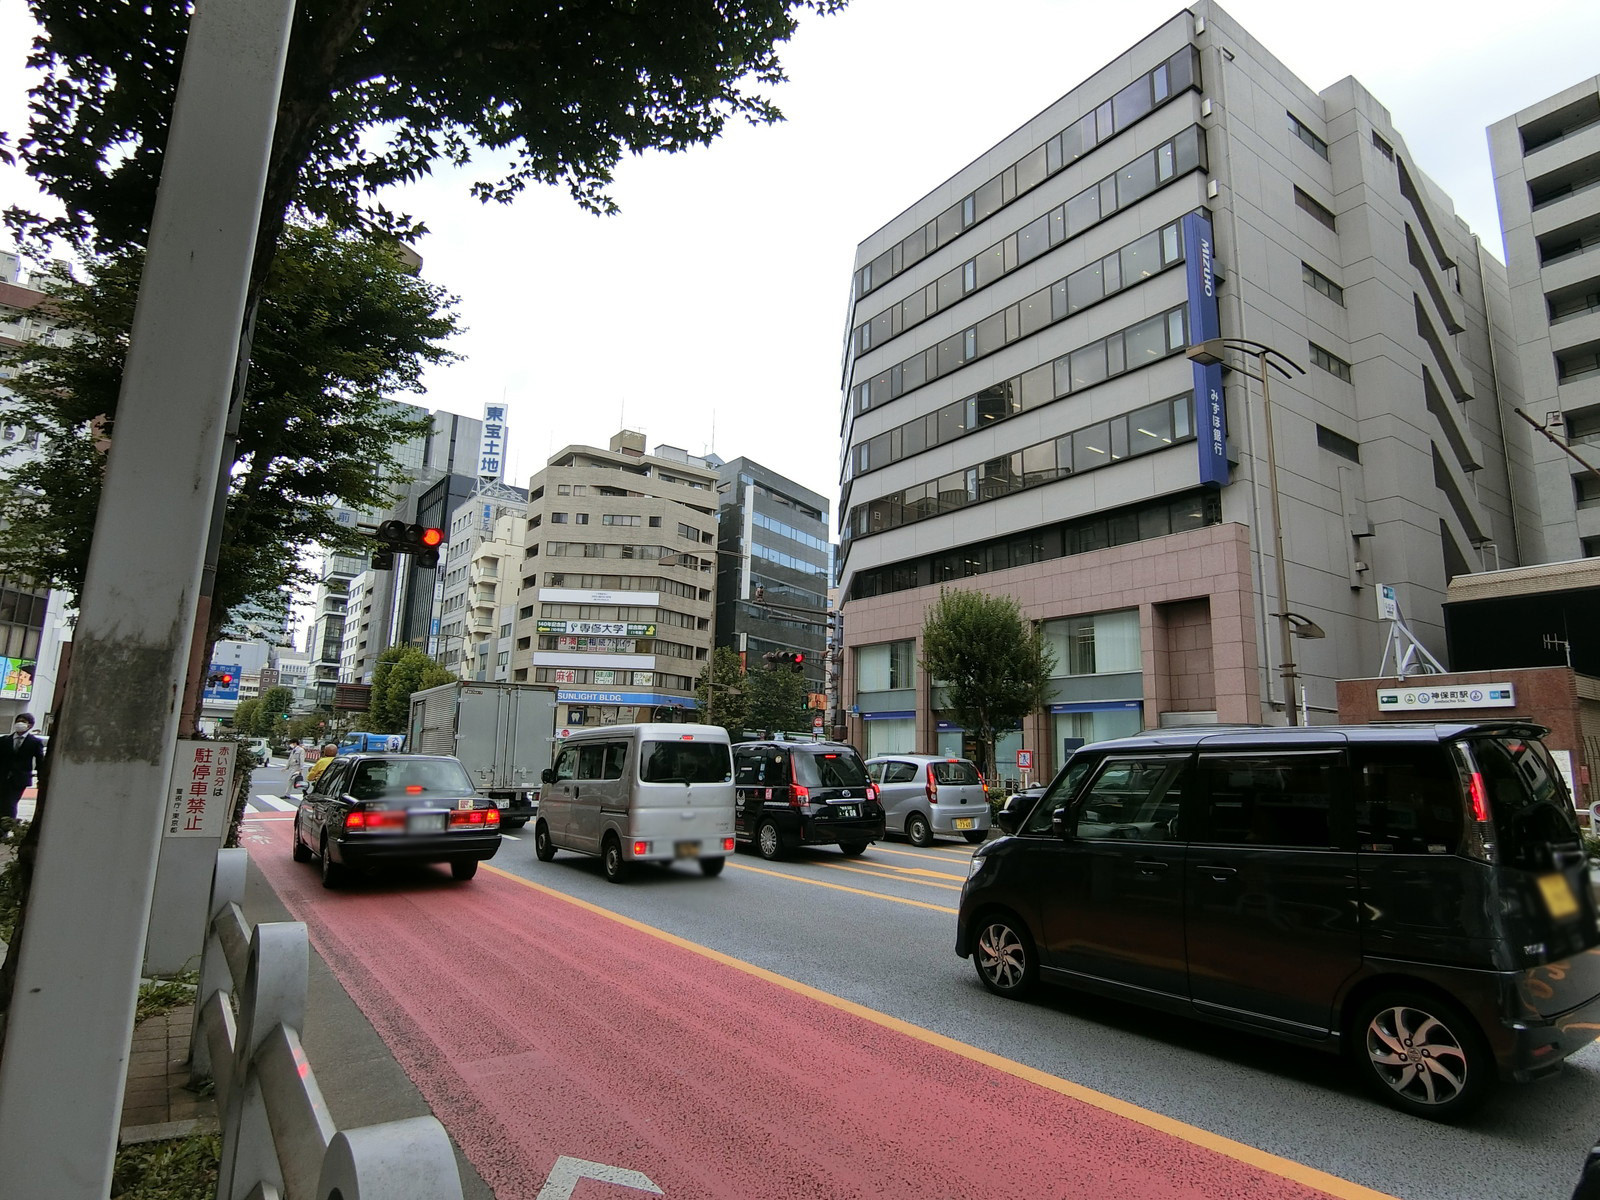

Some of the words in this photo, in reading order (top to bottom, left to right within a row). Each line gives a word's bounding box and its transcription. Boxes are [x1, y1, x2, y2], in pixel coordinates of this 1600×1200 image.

[1201, 238, 1212, 297] MIZUHO
[480, 406, 505, 473] 東宝土地
[1210, 389, 1223, 456] みずほ銀行
[580, 623, 624, 634] 専修大学
[557, 669, 574, 683] 麻雀
[557, 692, 597, 701] SUNLIGHT
[599, 694, 624, 702] BLDG.
[1431, 690, 1469, 699] 神保町駅
[183, 747, 214, 831] 駐停車禁止
[213, 746, 230, 797] 赤い部分は
